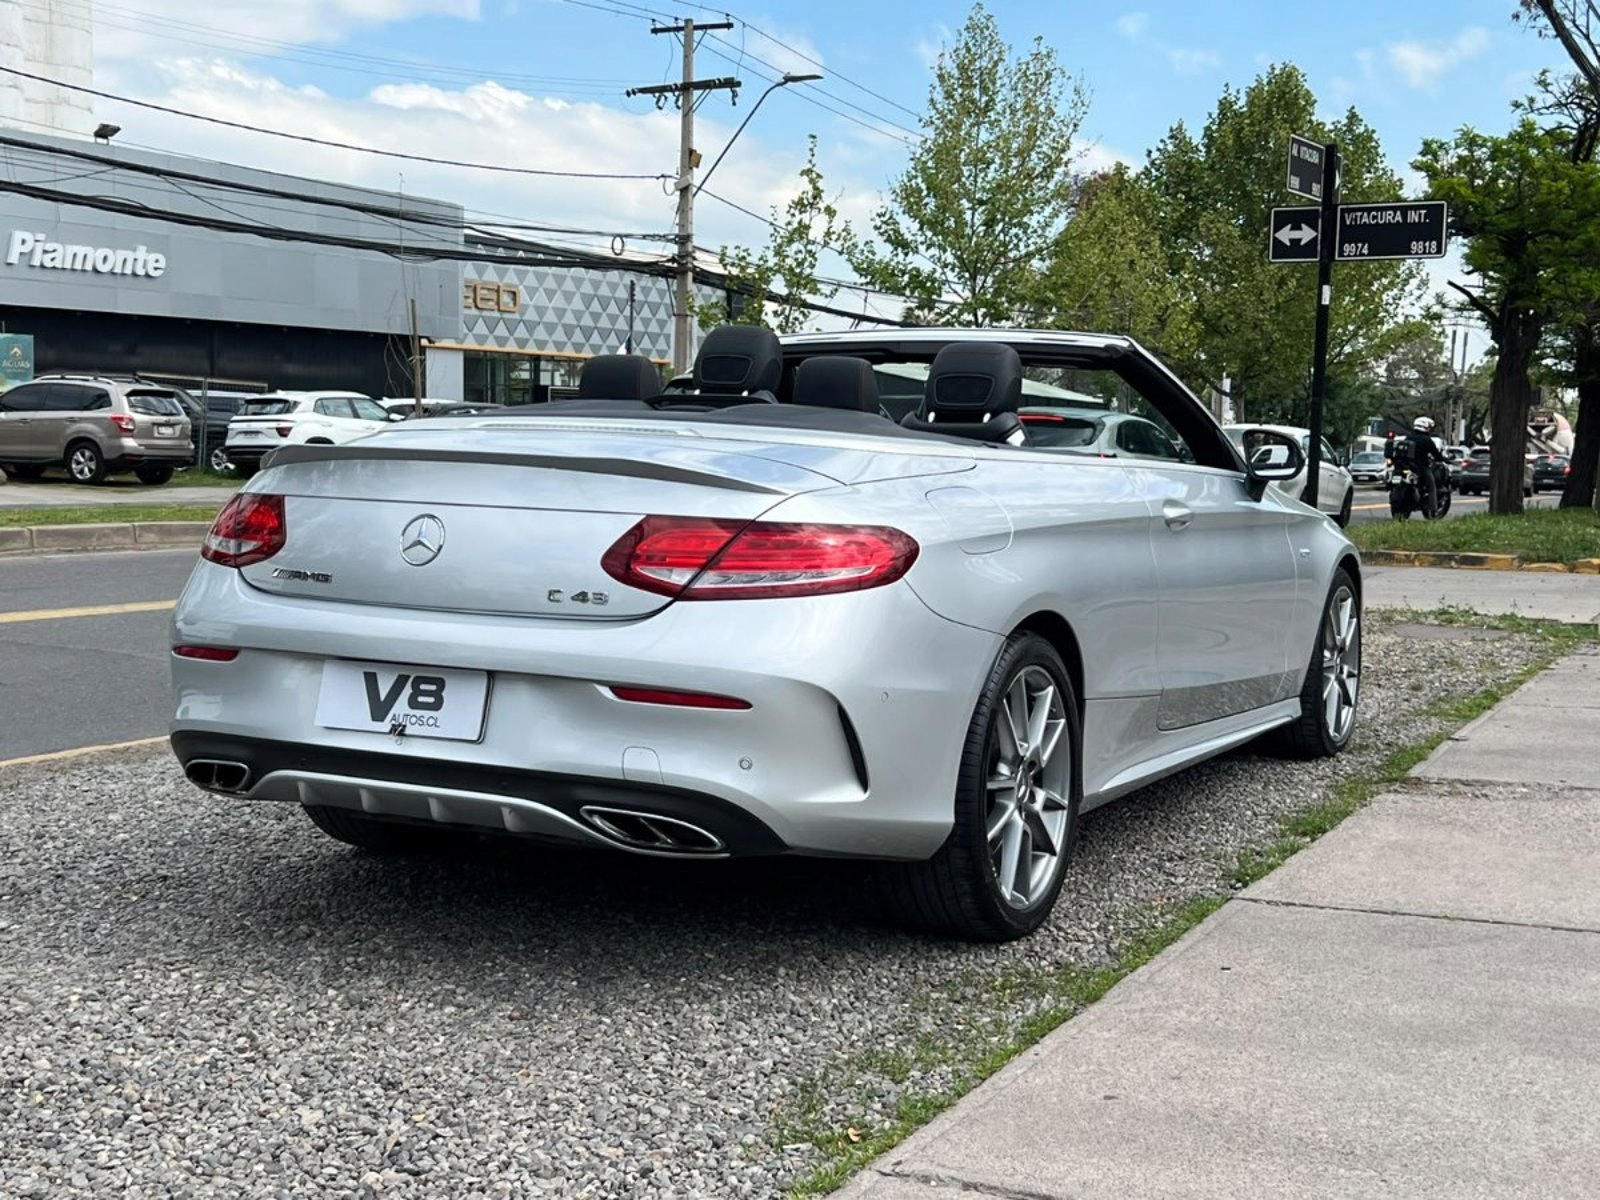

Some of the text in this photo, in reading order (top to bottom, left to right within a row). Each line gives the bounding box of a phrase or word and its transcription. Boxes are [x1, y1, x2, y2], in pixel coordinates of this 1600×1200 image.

[1345, 209, 1430, 225] VITACURA INT.
[5, 230, 166, 277] Piamonte
[1343, 243, 1369, 256] 9974
[1410, 240, 1437, 254] 9818
[547, 588, 609, 606] C 43
[363, 671, 446, 723] V8
